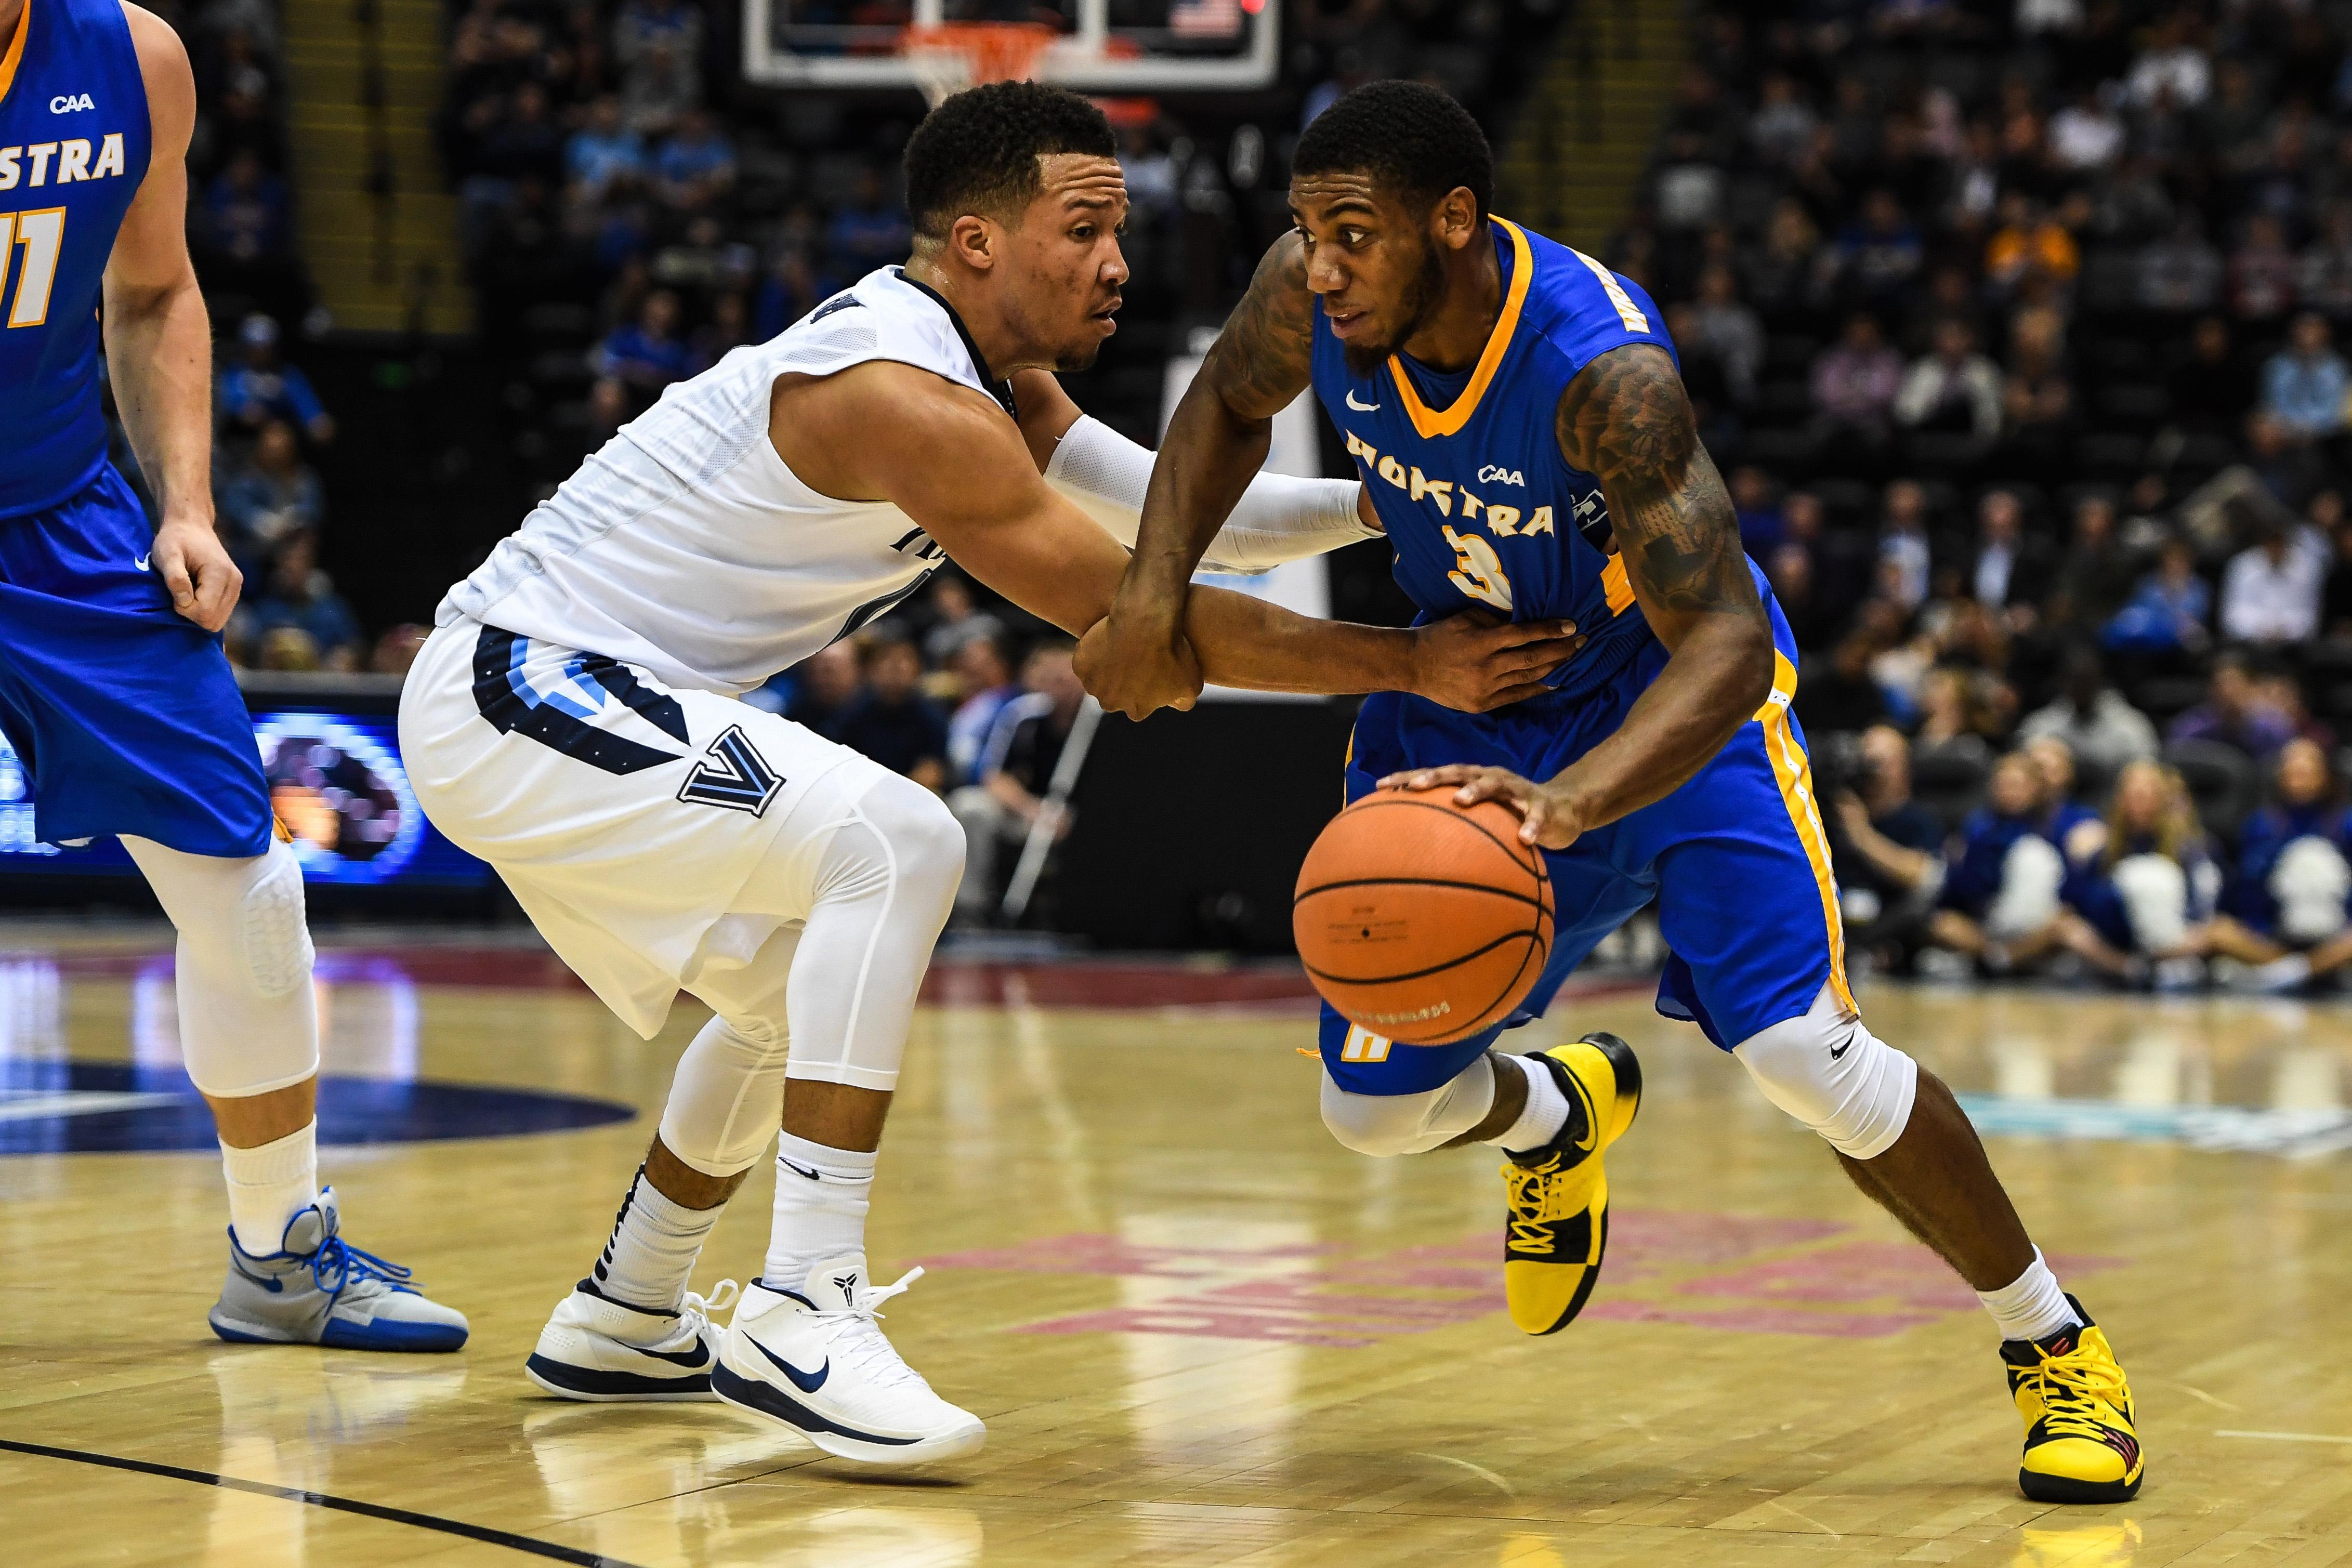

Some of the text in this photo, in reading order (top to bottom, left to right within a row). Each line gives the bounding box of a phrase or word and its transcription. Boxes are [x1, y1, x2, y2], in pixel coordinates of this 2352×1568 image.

[49, 93, 95, 114] CAA
[0, 206, 66, 328] 1
[1478, 464, 1525, 487] CAA
[1442, 525, 1513, 612] 3
[676, 723, 787, 819] V
